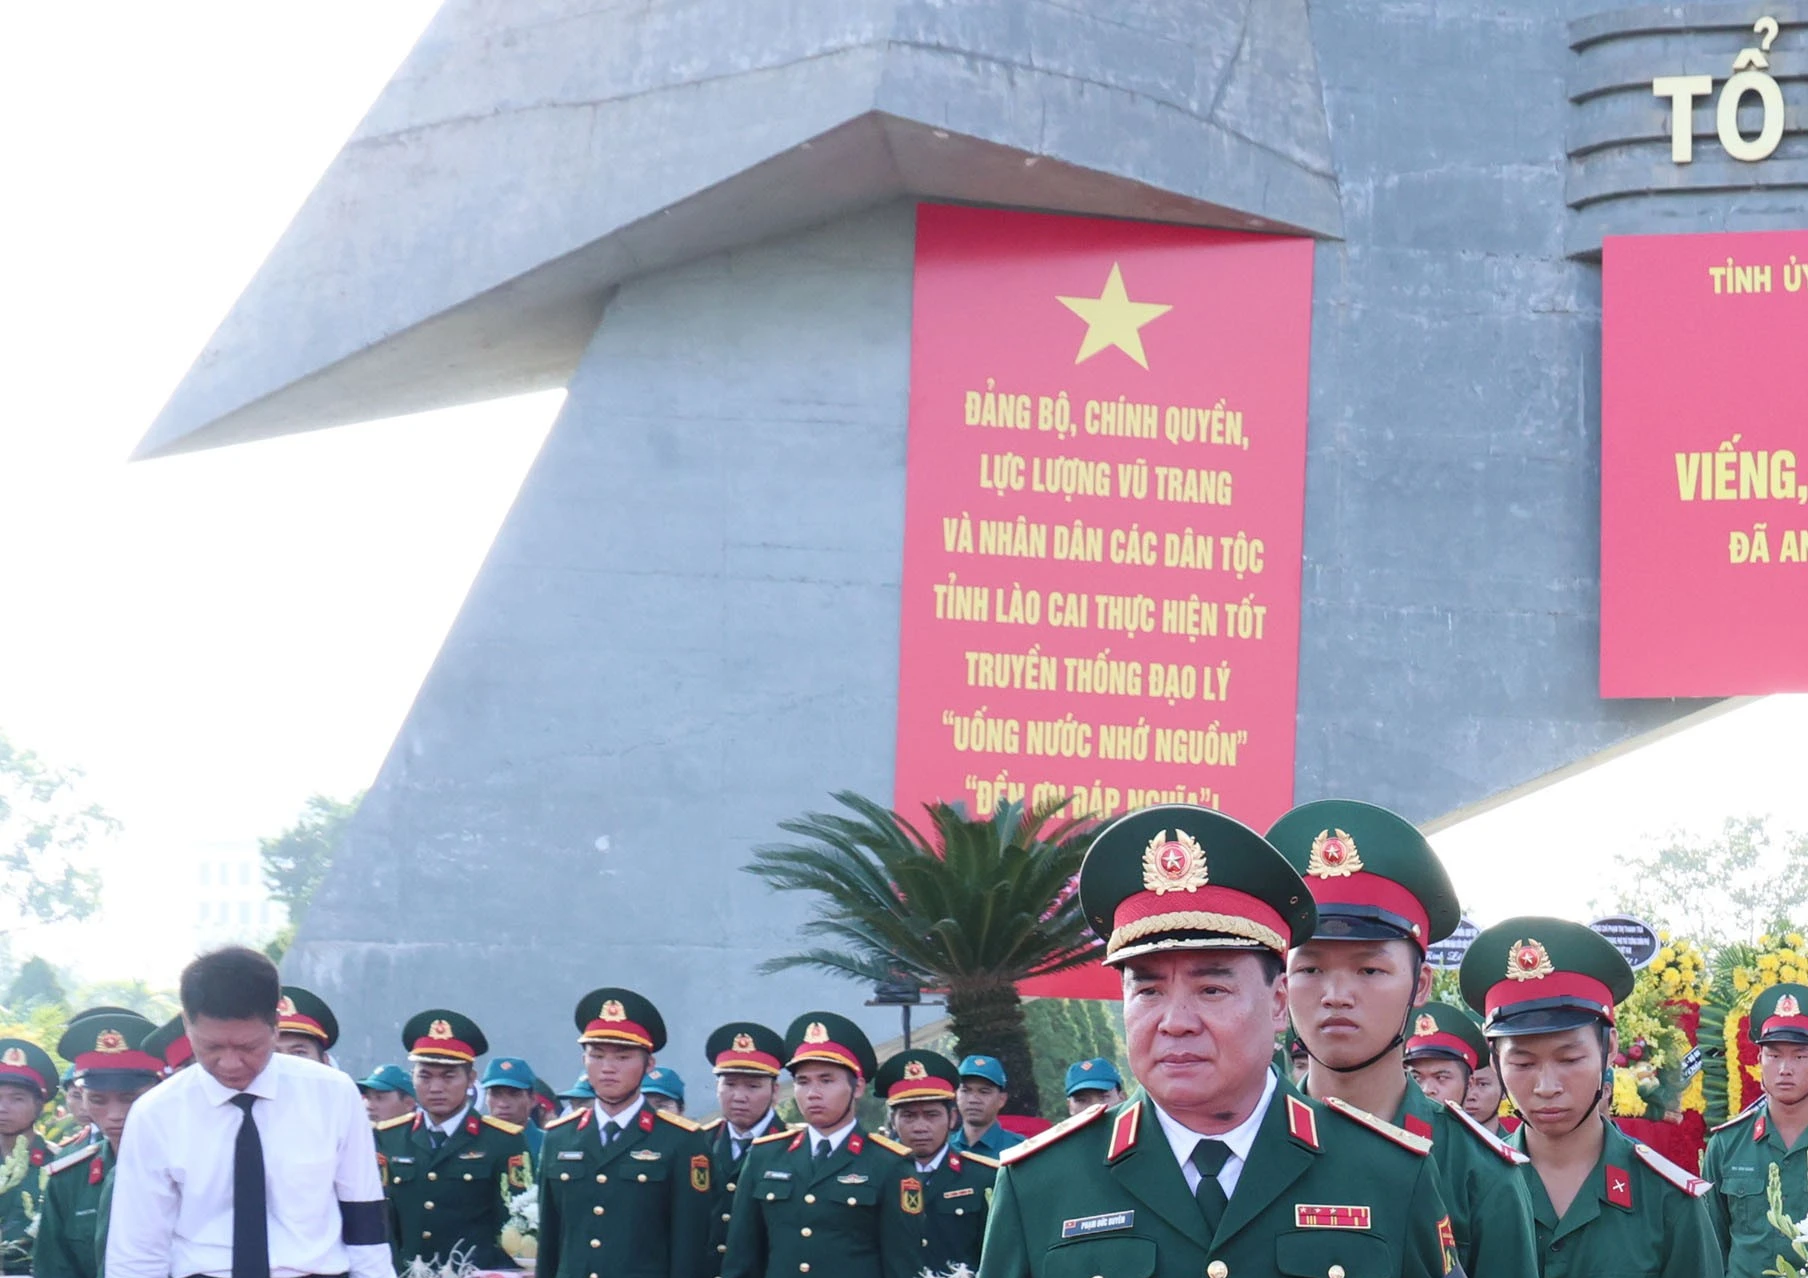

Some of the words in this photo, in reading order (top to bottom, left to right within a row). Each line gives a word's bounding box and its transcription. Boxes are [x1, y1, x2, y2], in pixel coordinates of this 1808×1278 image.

[1652, 16, 1786, 165] TỔ
[1708, 258, 1772, 293] TỈNH
[965, 379, 1032, 430] ĐẢNG
[1037, 391, 1078, 440] BỘ,
[1084, 396, 1159, 439] CHÍNH
[1164, 400, 1249, 448] QUYỀN,
[980, 452, 1026, 496] LỰC
[1032, 456, 1112, 501] LƯỢNG
[1117, 458, 1150, 499] VŨ
[1154, 465, 1232, 505] TRANG
[1675, 435, 1808, 504] VIẾNG,
[943, 512, 974, 553] VÀ
[979, 516, 1048, 558] NHÂN
[1053, 520, 1104, 561] DÂN
[1110, 524, 1158, 566] CÁC
[1163, 528, 1214, 569] DÂN
[1219, 531, 1264, 580] TỘC
[1729, 523, 1771, 564] ĐÃ
[934, 572, 990, 622] TỈNH
[995, 582, 1041, 624] LÀO
[1047, 592, 1088, 628] CAI
[1095, 594, 1156, 637] THỰC
[1161, 594, 1219, 640] HIỆN
[1224, 594, 1268, 639] TỐT
[964, 644, 1058, 690] TRUYỀN
[1064, 649, 1143, 696] THỐNG
[1148, 663, 1197, 704] ĐẠO
[1203, 661, 1231, 701] LÝ
[942, 706, 1020, 753] “UỐNG
[1026, 713, 1092, 758] NƯỚC
[1098, 717, 1151, 761] NHỚ
[1154, 720, 1248, 766] NGUỒN”
[1072, 779, 1121, 820] ĐÁP
